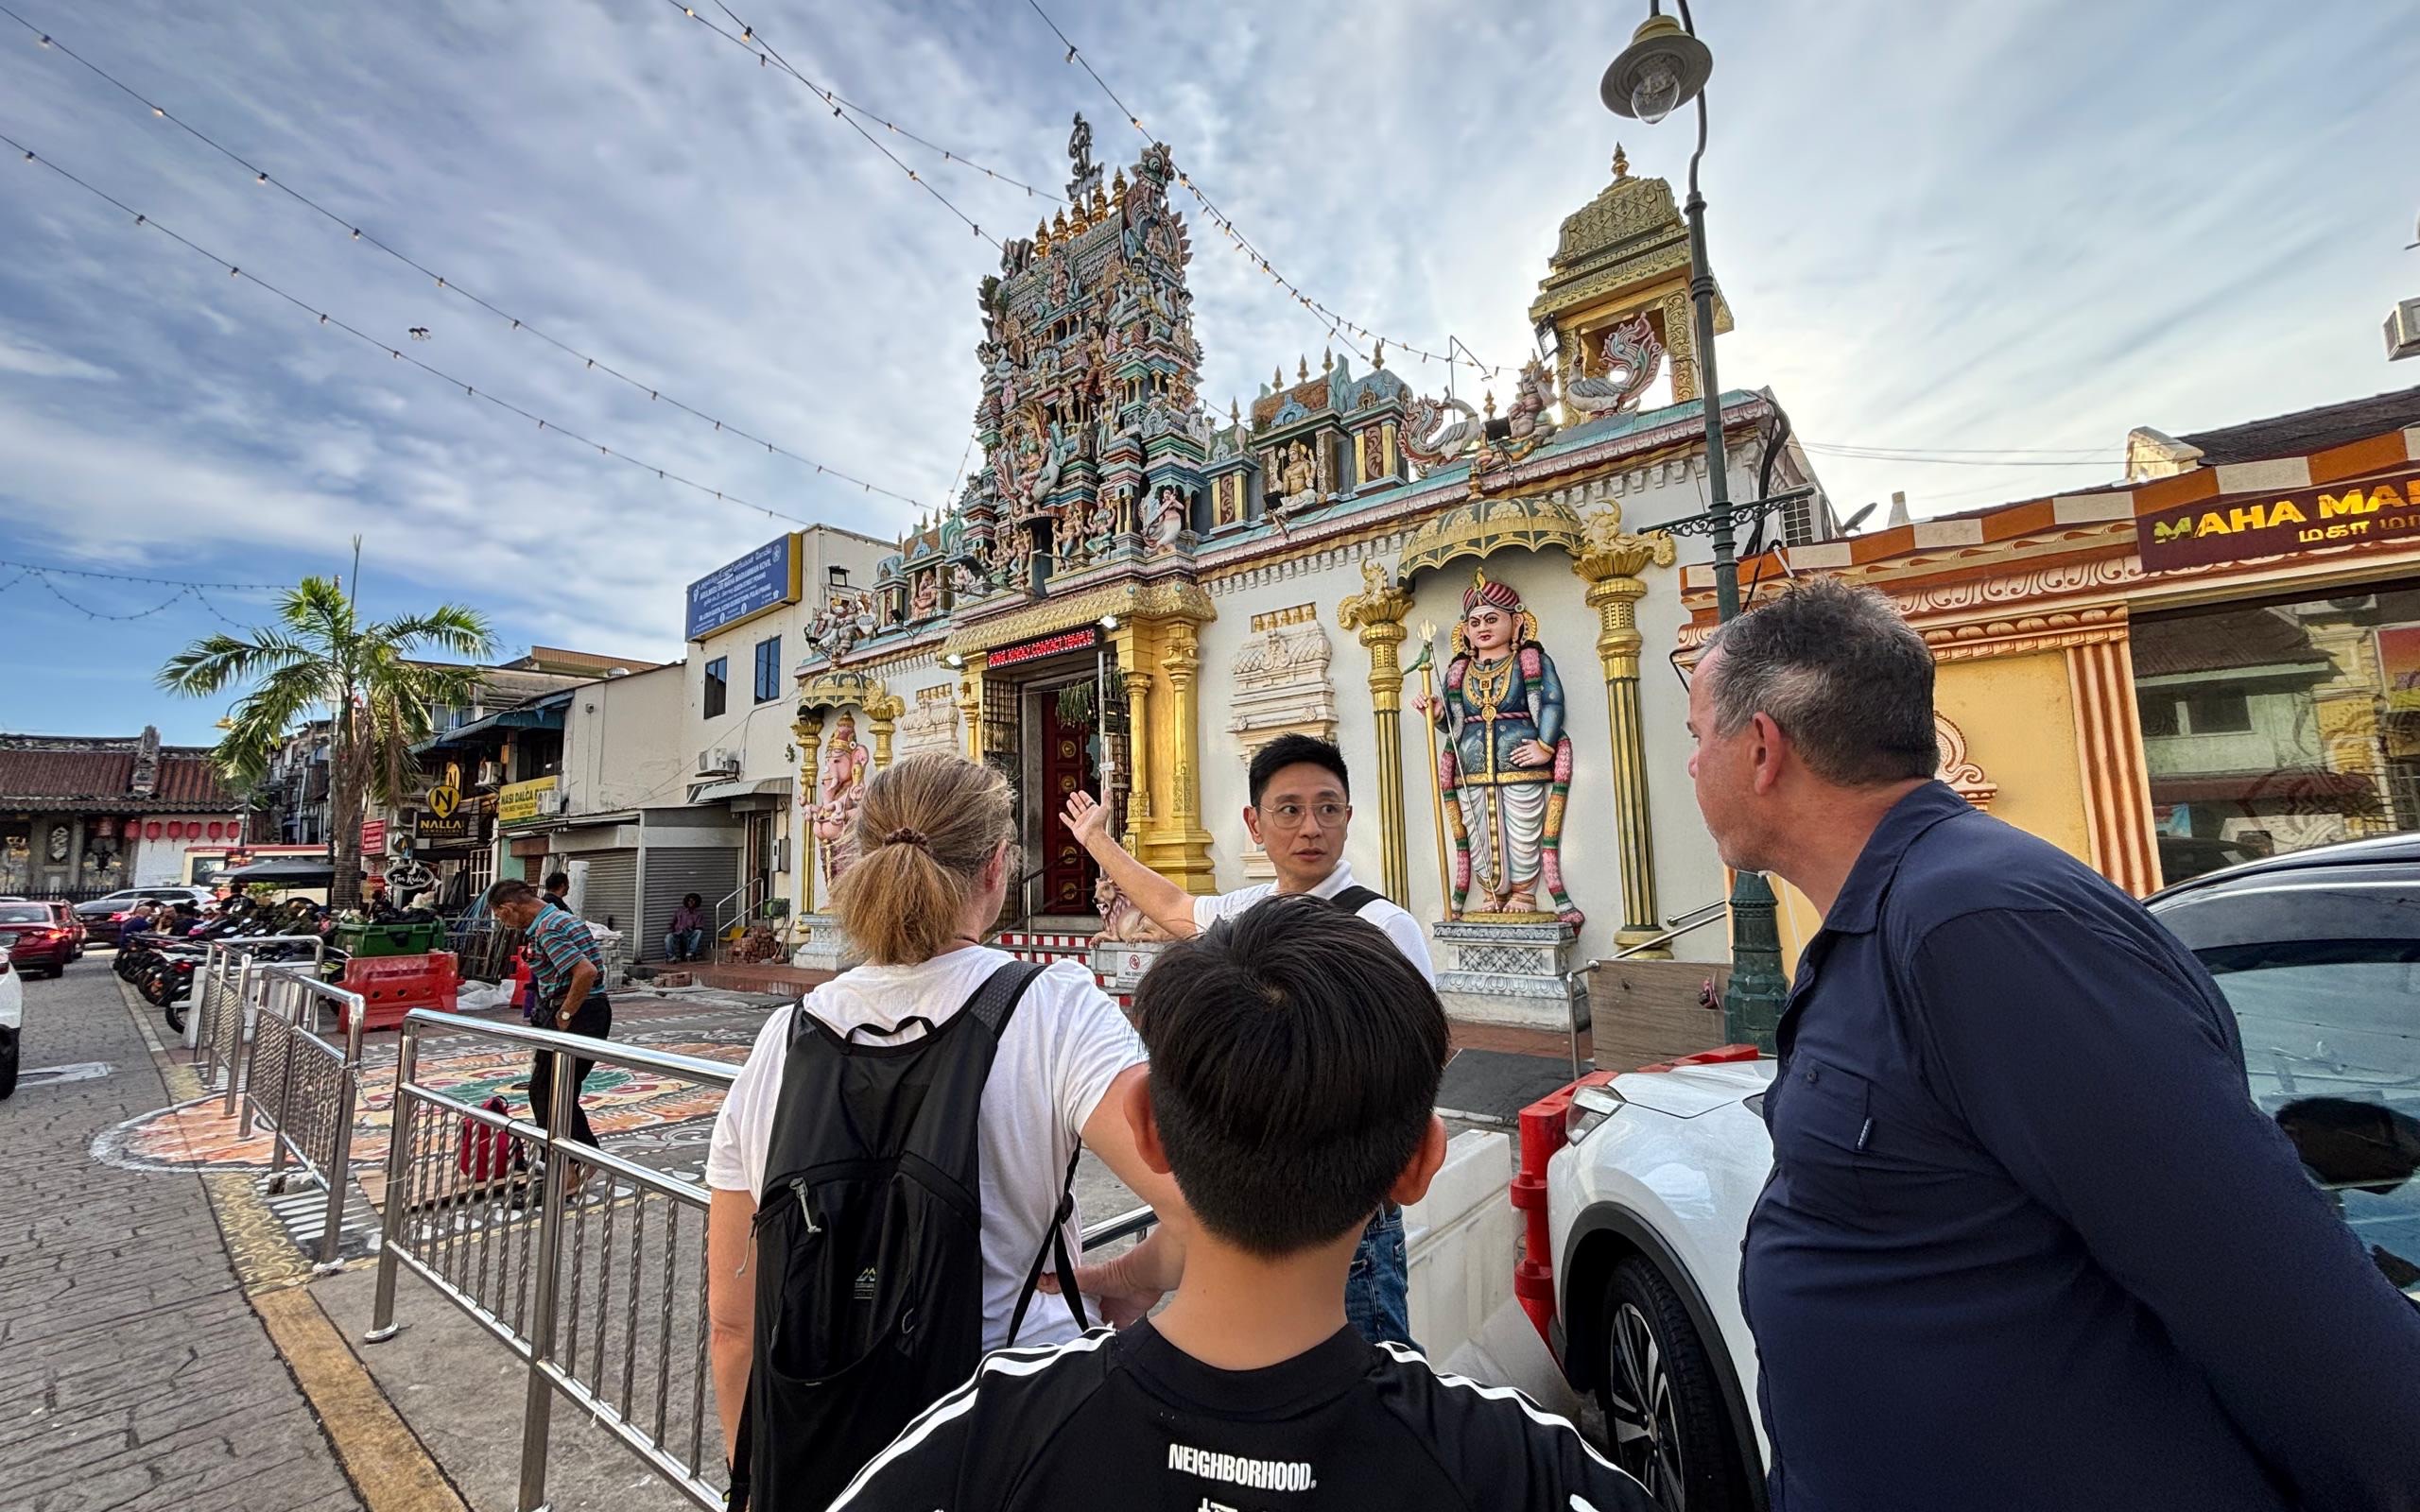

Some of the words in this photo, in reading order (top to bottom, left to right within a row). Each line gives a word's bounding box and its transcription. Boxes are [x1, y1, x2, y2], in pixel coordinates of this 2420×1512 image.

[2153, 500, 2307, 544] MAHA
[1031, 640, 1062, 656] CONTACT
[1064, 631, 1092, 647] TEMPLE
[501, 793, 514, 805] NASI
[420, 819, 462, 829] NALLA
